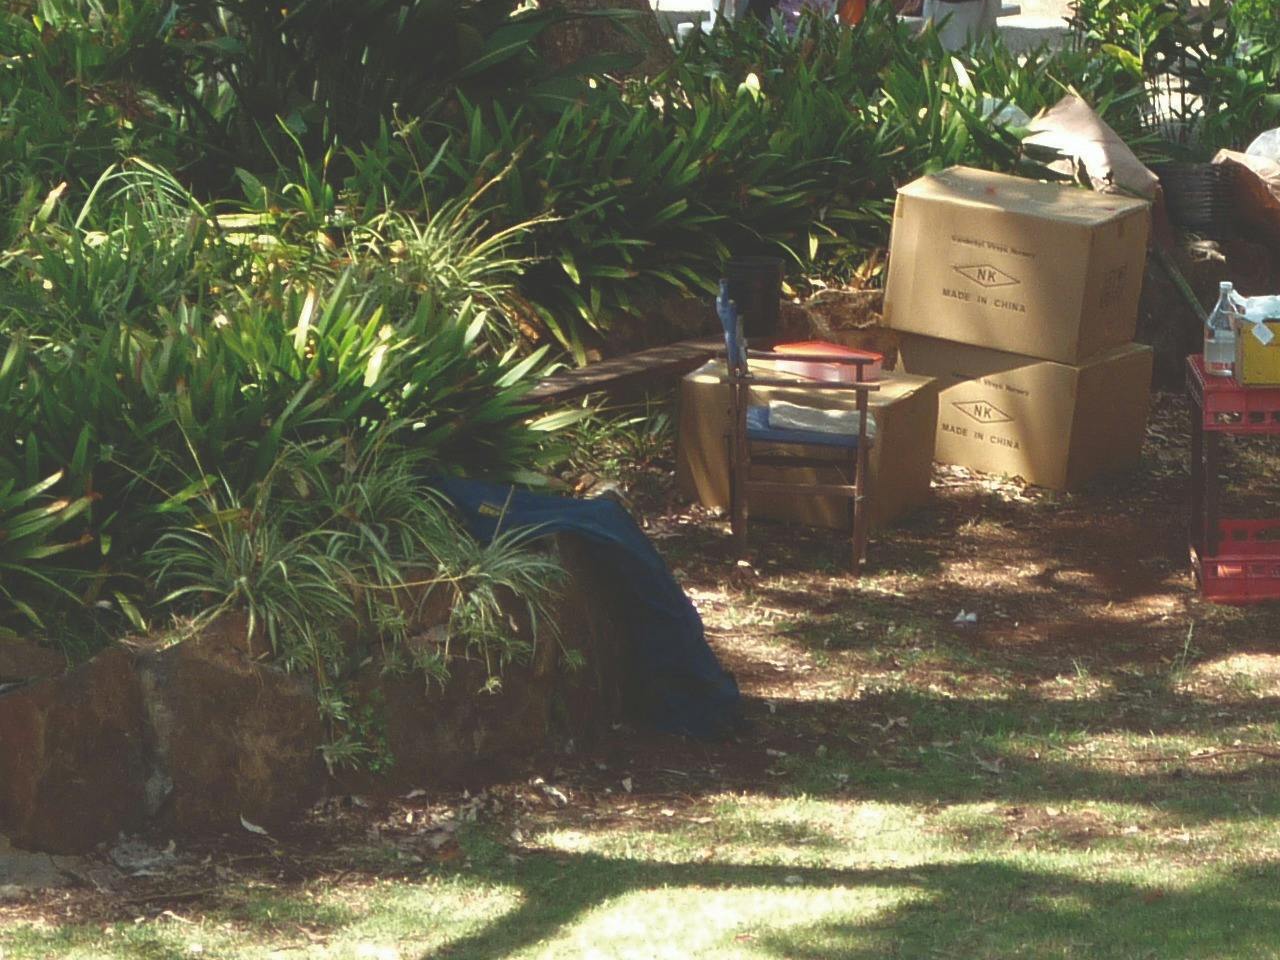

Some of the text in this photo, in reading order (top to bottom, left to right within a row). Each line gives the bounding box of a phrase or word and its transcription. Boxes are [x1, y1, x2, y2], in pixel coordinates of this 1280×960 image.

[977, 269, 997, 283] NK
[942, 288, 1026, 313] MADE IN CHINA
[974, 405, 992, 419] NK
[942, 423, 1021, 450] MADE IN CHINA
